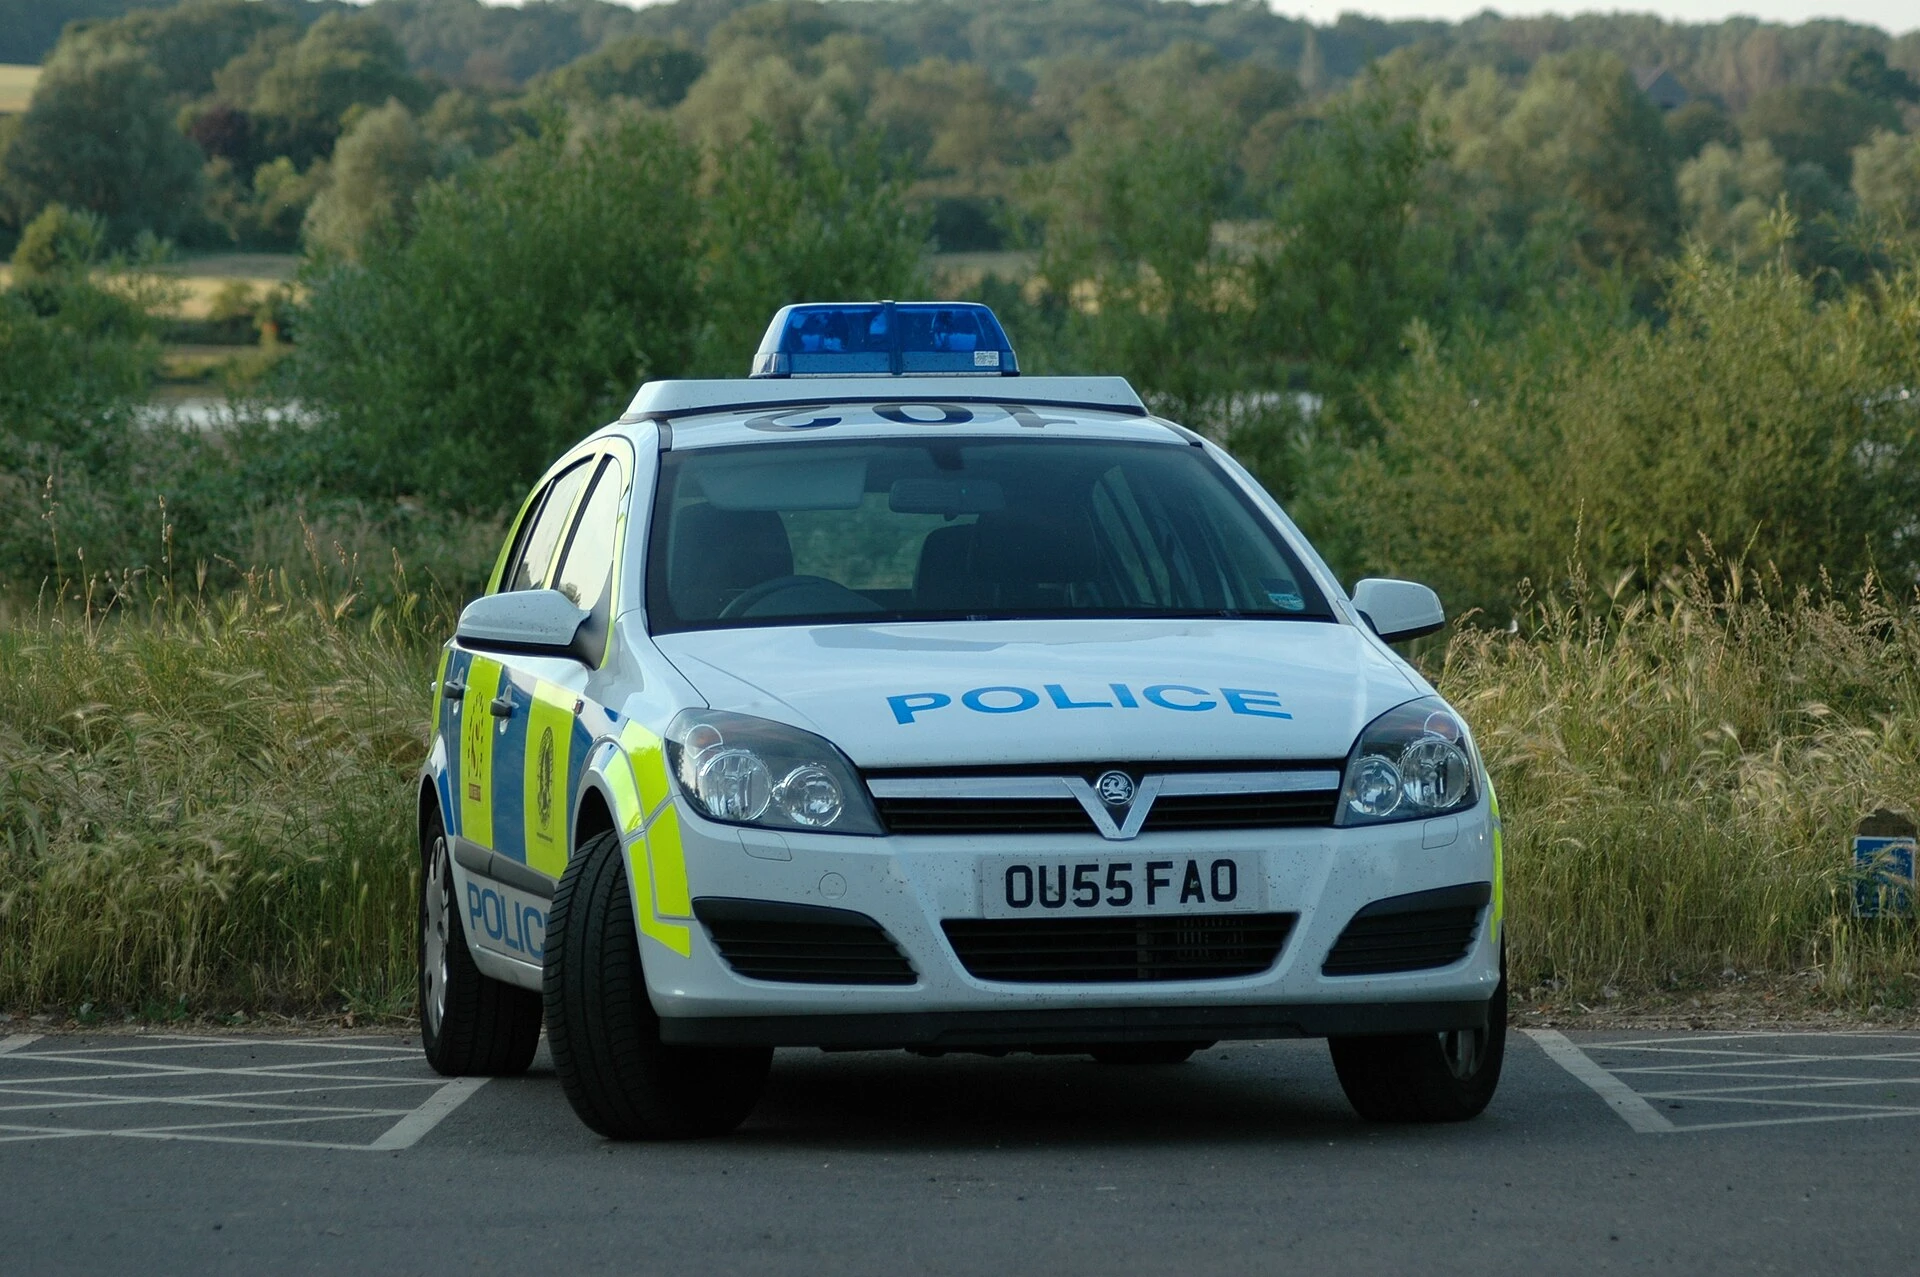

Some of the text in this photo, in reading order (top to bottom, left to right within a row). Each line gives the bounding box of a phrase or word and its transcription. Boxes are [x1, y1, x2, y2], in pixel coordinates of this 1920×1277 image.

[886, 683, 1294, 725] POLICE
[1005, 862, 1133, 909] OU55
[467, 881, 550, 960] POLIC
